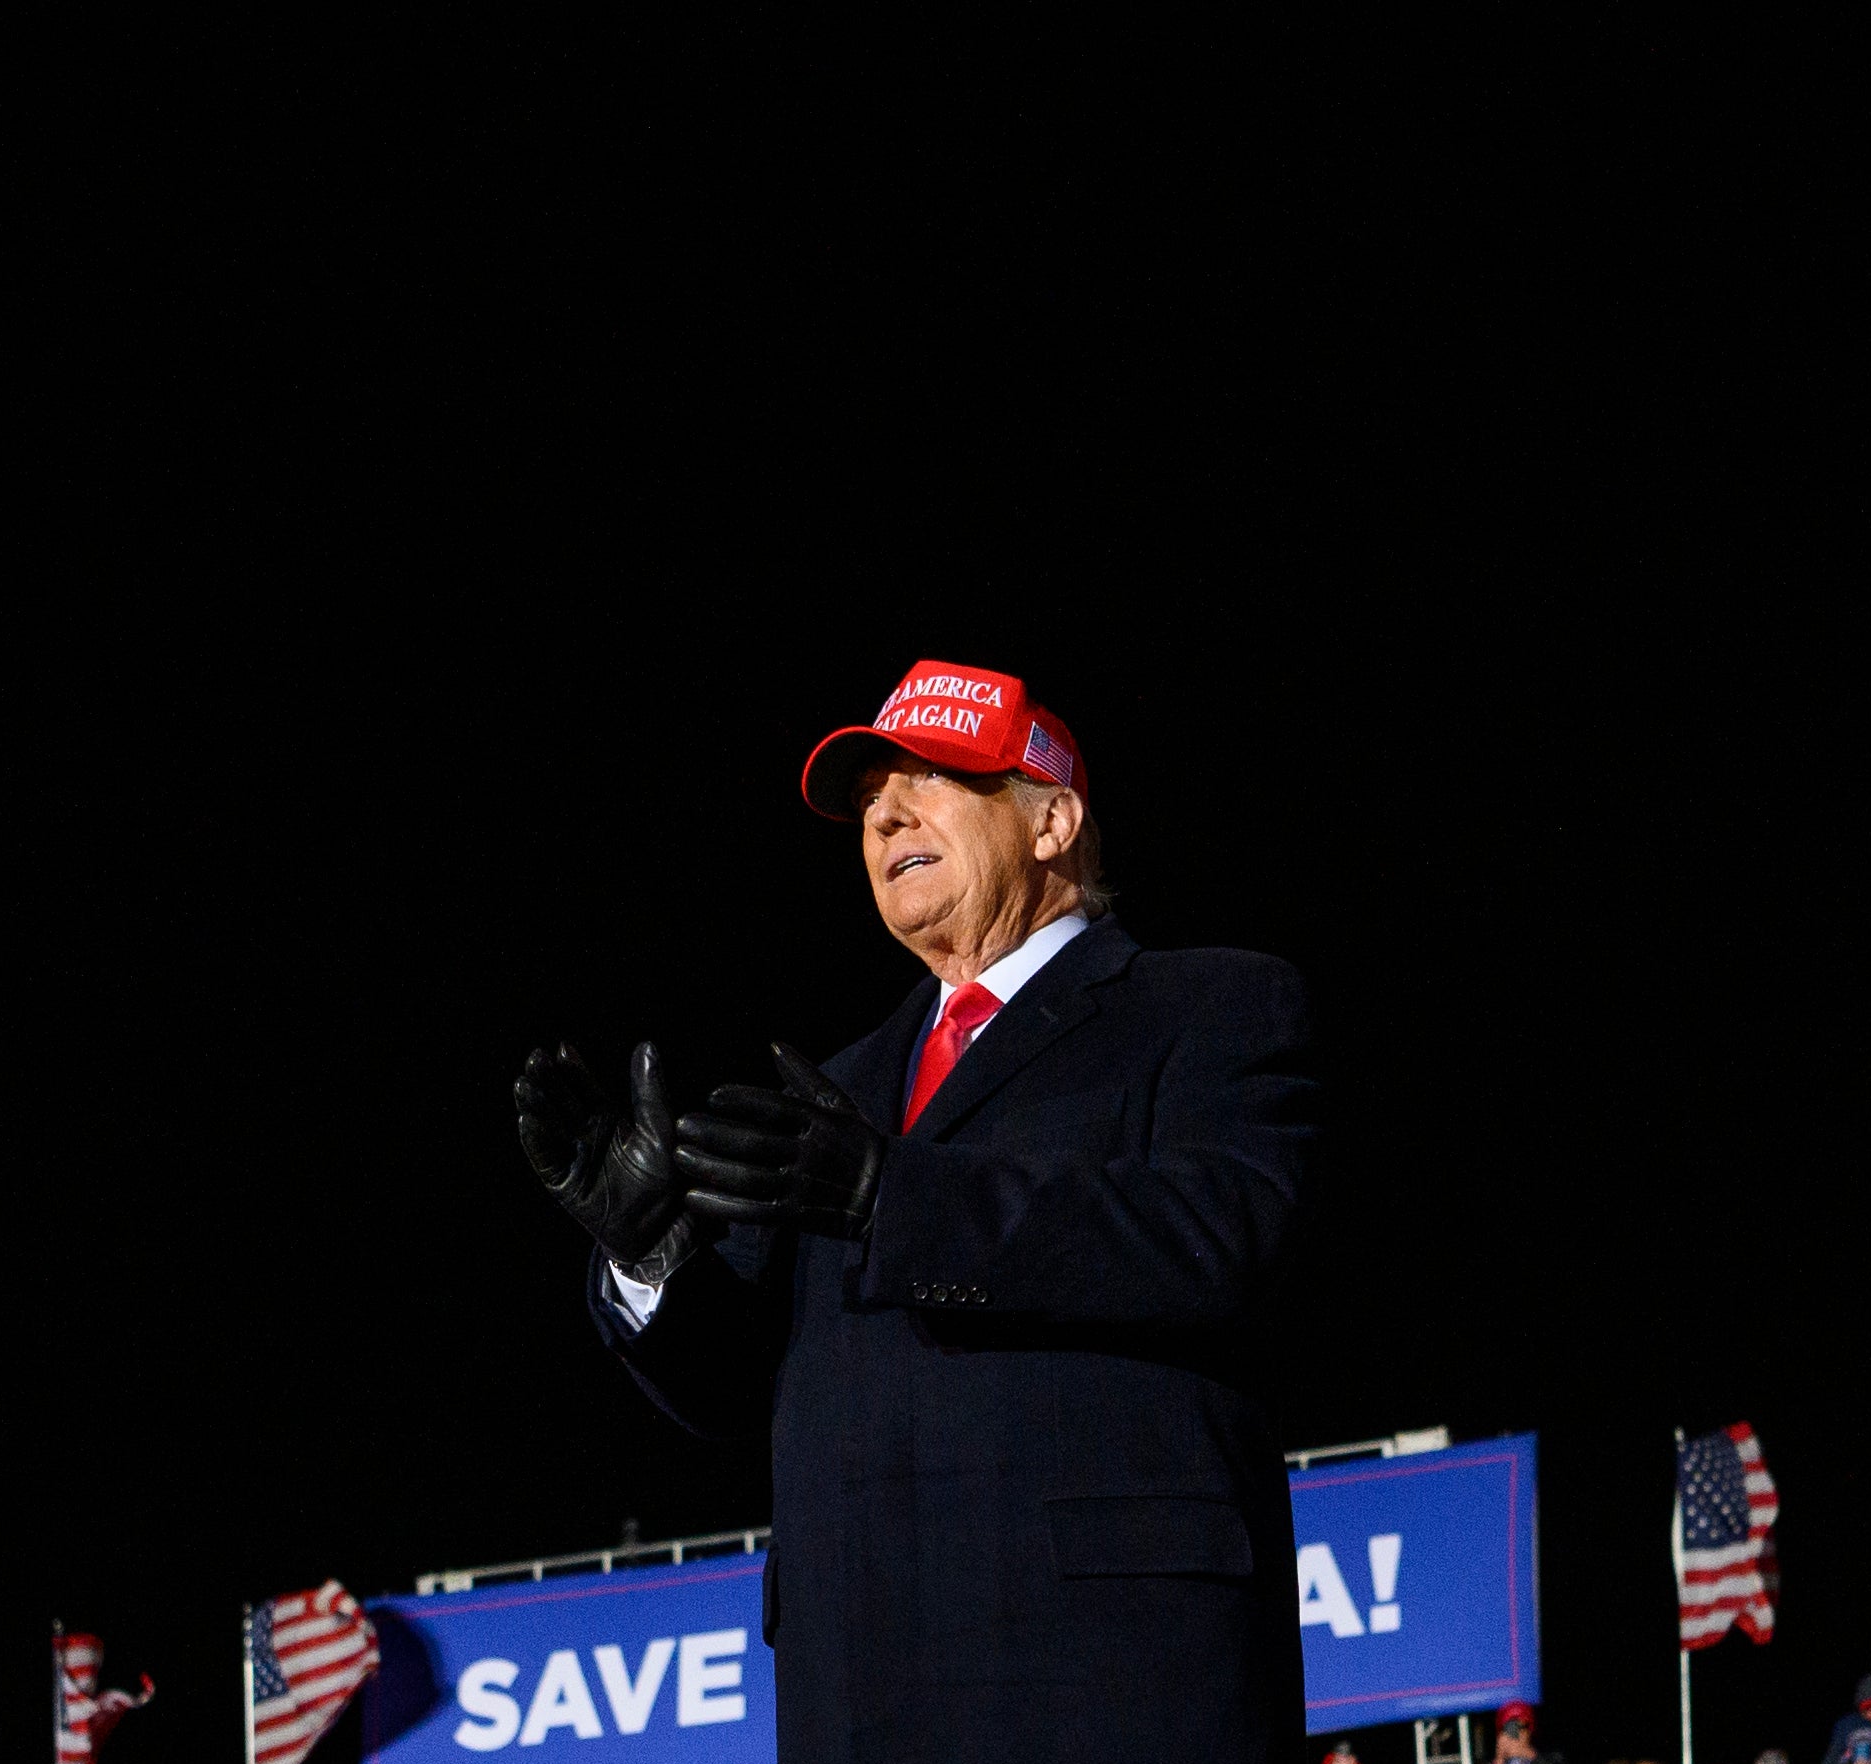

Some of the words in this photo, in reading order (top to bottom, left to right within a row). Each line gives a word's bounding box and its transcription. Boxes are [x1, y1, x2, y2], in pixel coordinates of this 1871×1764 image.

[896, 675, 1003, 709] AMERICA
[903, 704, 984, 738] AGAIN
[453, 1627, 748, 1751] SAVE
[1297, 1533, 1402, 1639] A!
